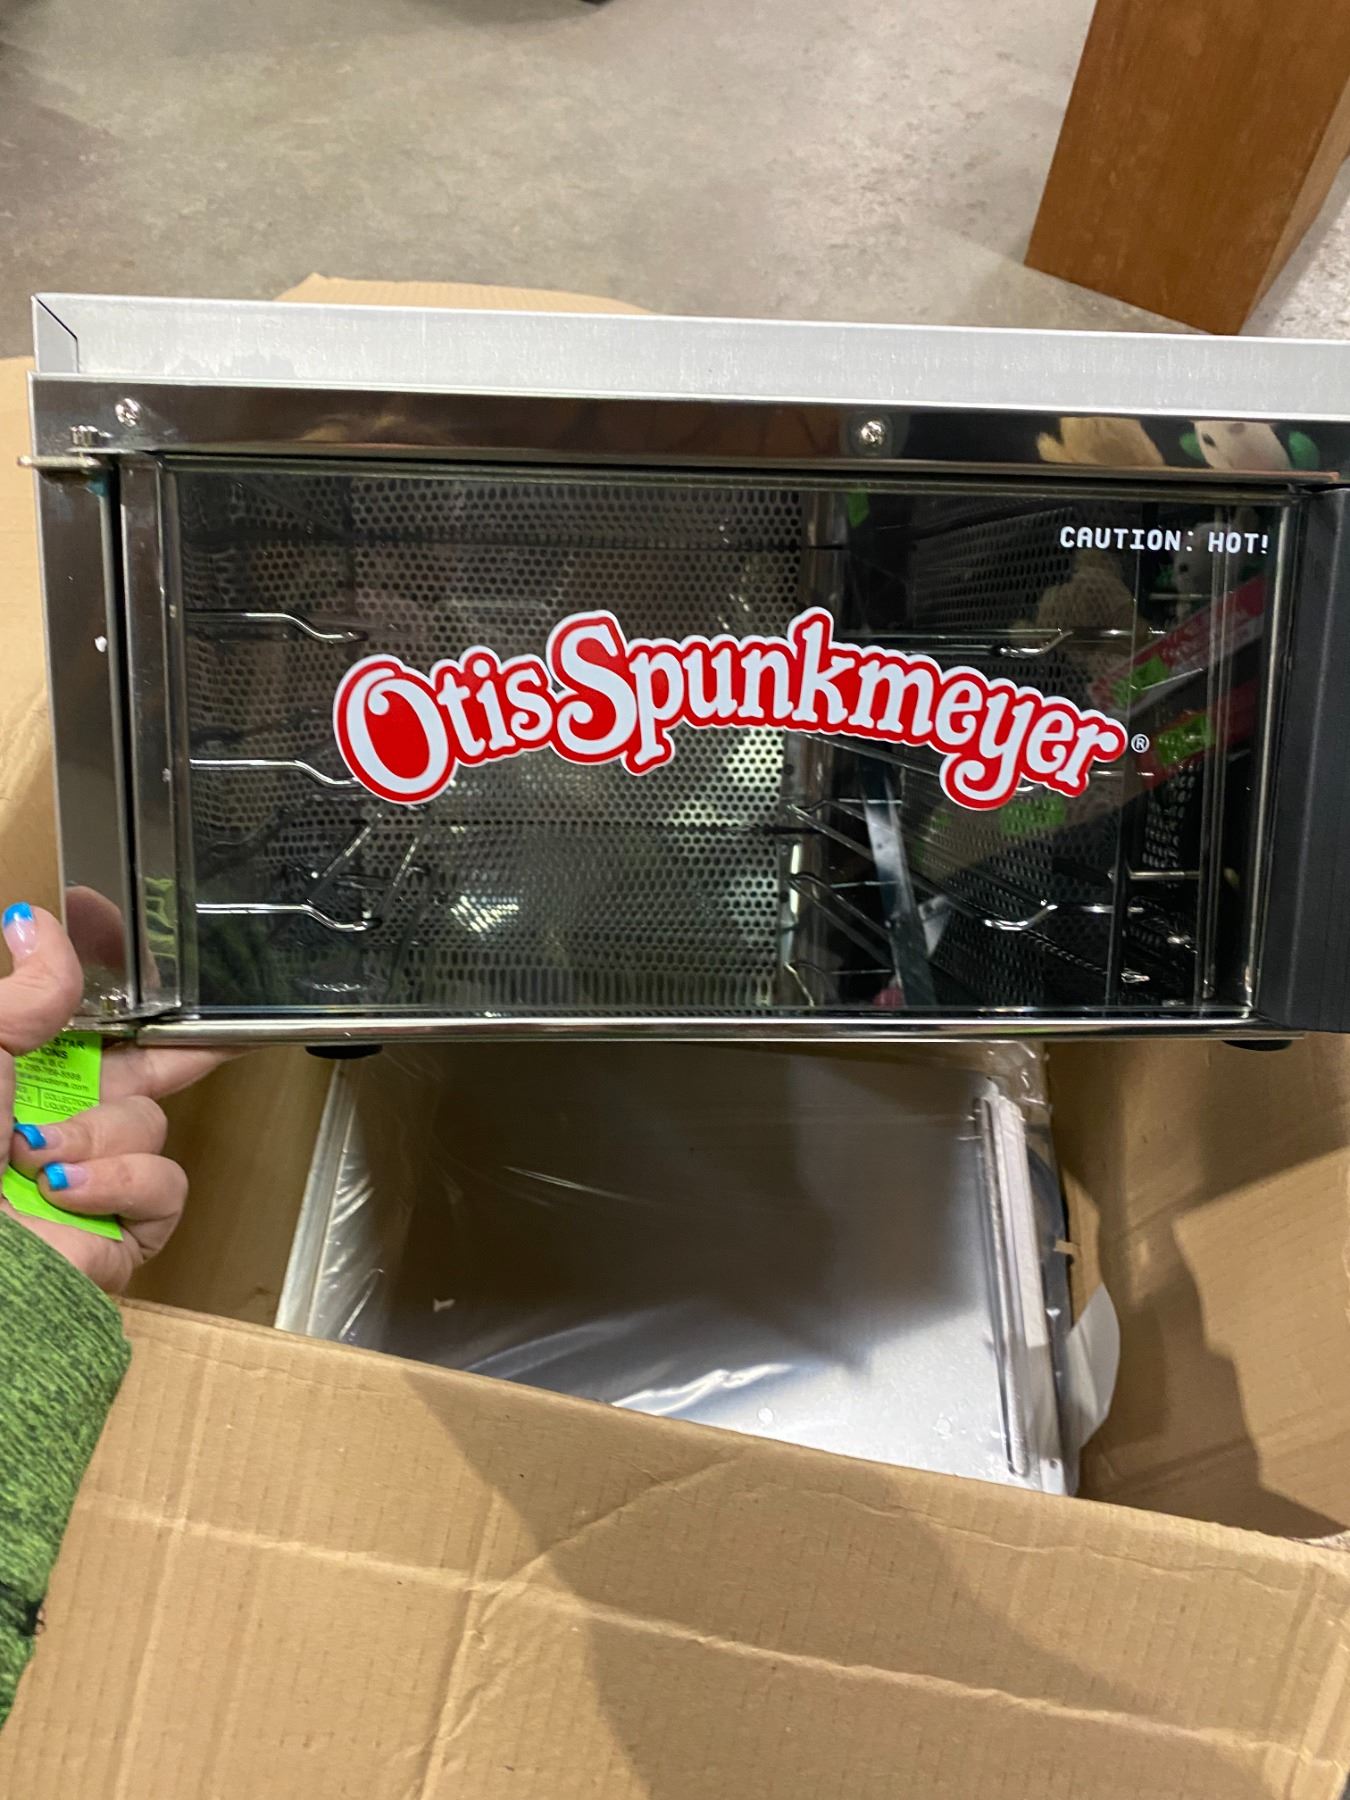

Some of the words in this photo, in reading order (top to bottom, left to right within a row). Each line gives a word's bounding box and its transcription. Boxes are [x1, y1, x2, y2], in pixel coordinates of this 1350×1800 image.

[1060, 526, 1193, 552] CAUTION:
[1208, 531, 1269, 554] HOT!
[54, 1036, 85, 1050] STAR
